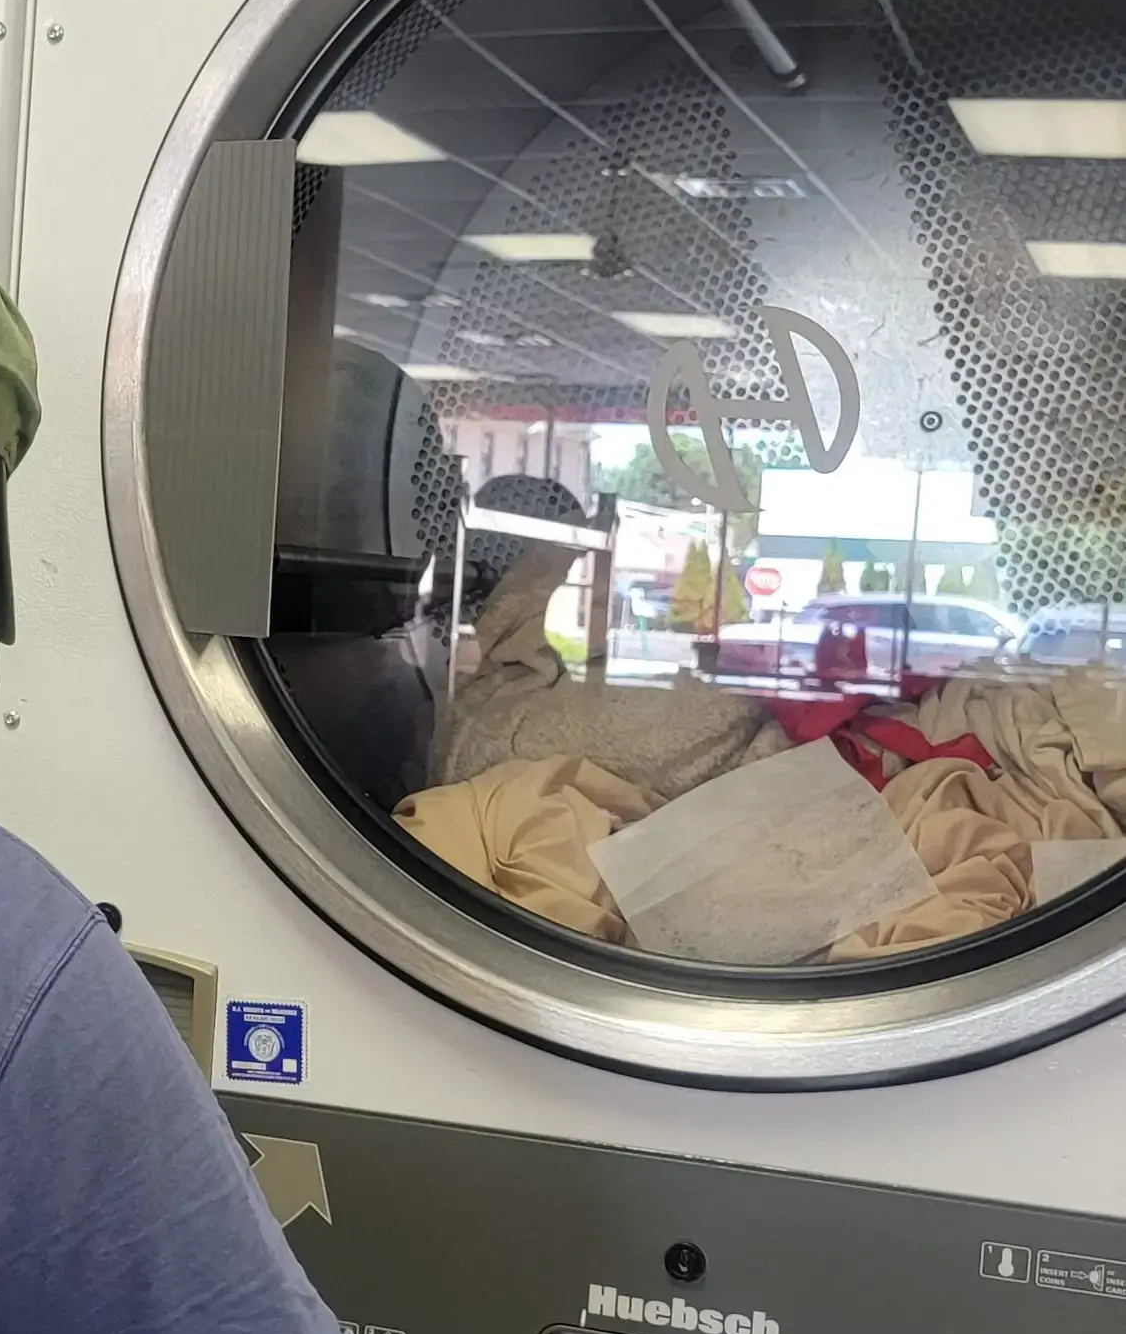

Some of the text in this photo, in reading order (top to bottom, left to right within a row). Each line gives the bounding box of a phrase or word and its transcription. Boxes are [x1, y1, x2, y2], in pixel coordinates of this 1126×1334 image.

[1041, 1253, 1050, 1263] 2
[1040, 1267, 1068, 1278] INSERT
[1039, 1276, 1065, 1286] COINS
